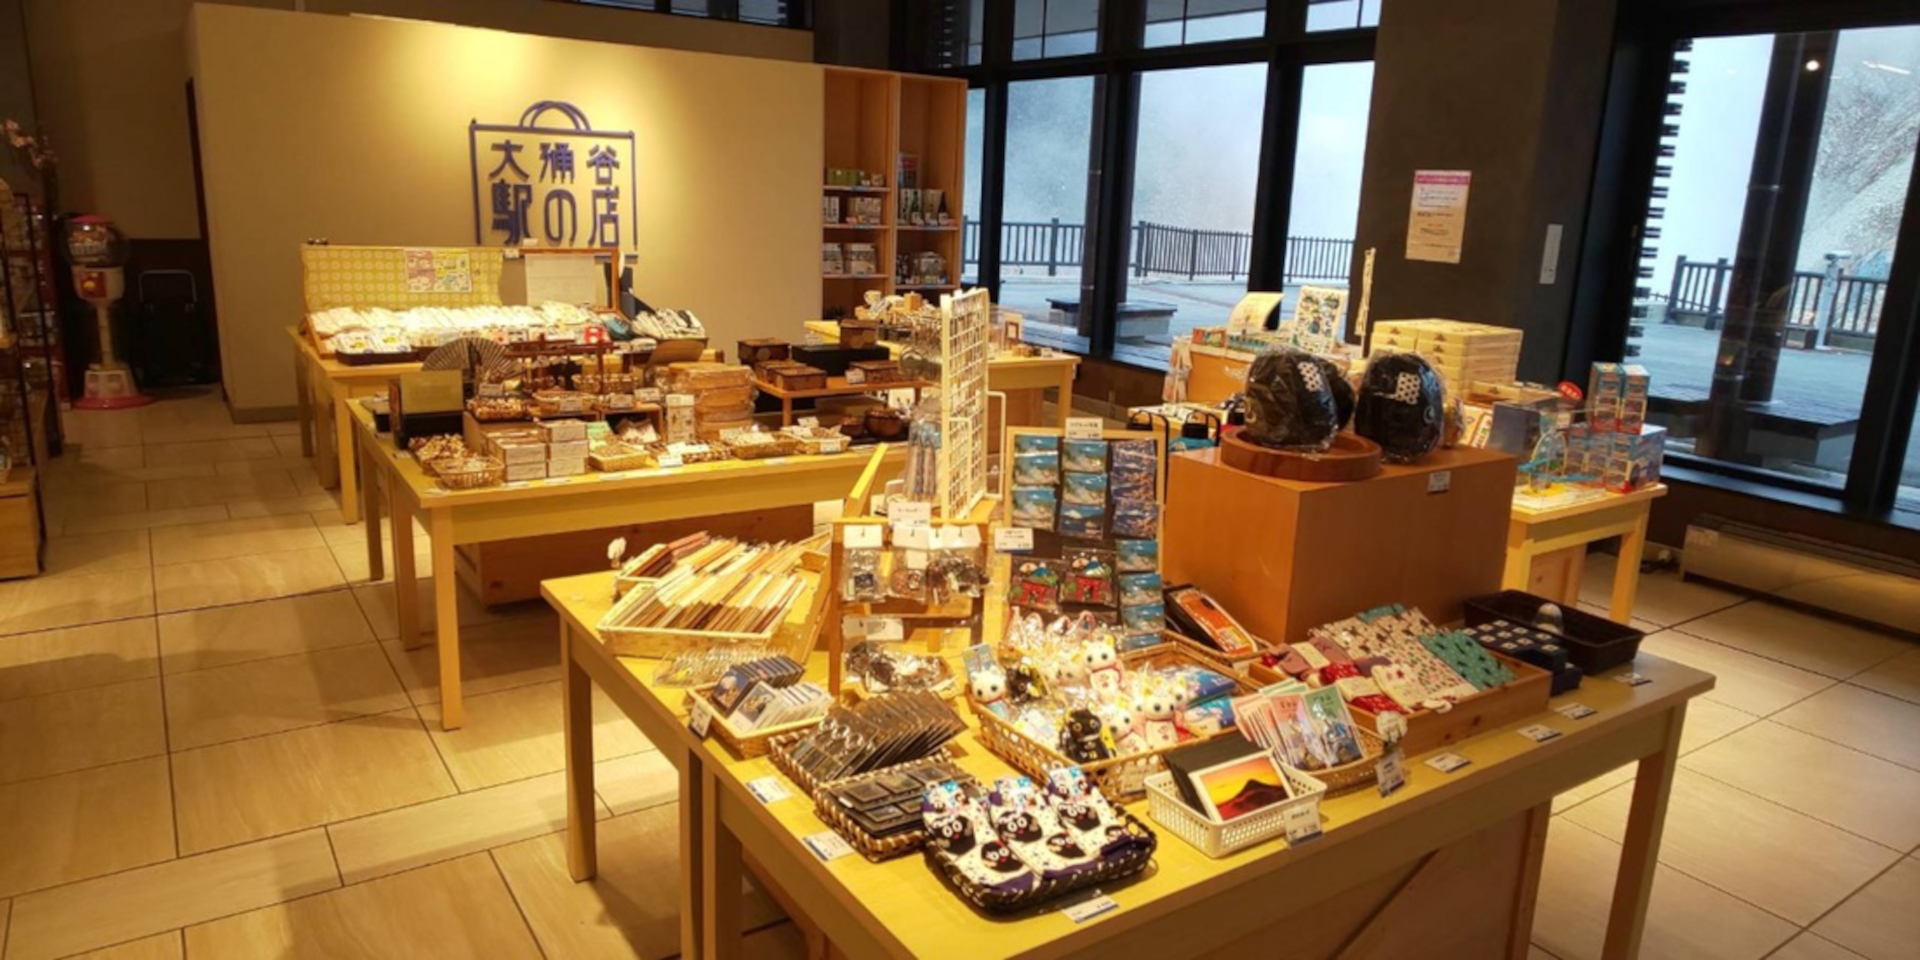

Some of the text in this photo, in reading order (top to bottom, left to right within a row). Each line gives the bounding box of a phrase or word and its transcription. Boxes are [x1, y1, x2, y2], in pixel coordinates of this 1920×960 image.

[489, 139, 620, 184] 大涌谷
[491, 179, 620, 247] 駅の店
